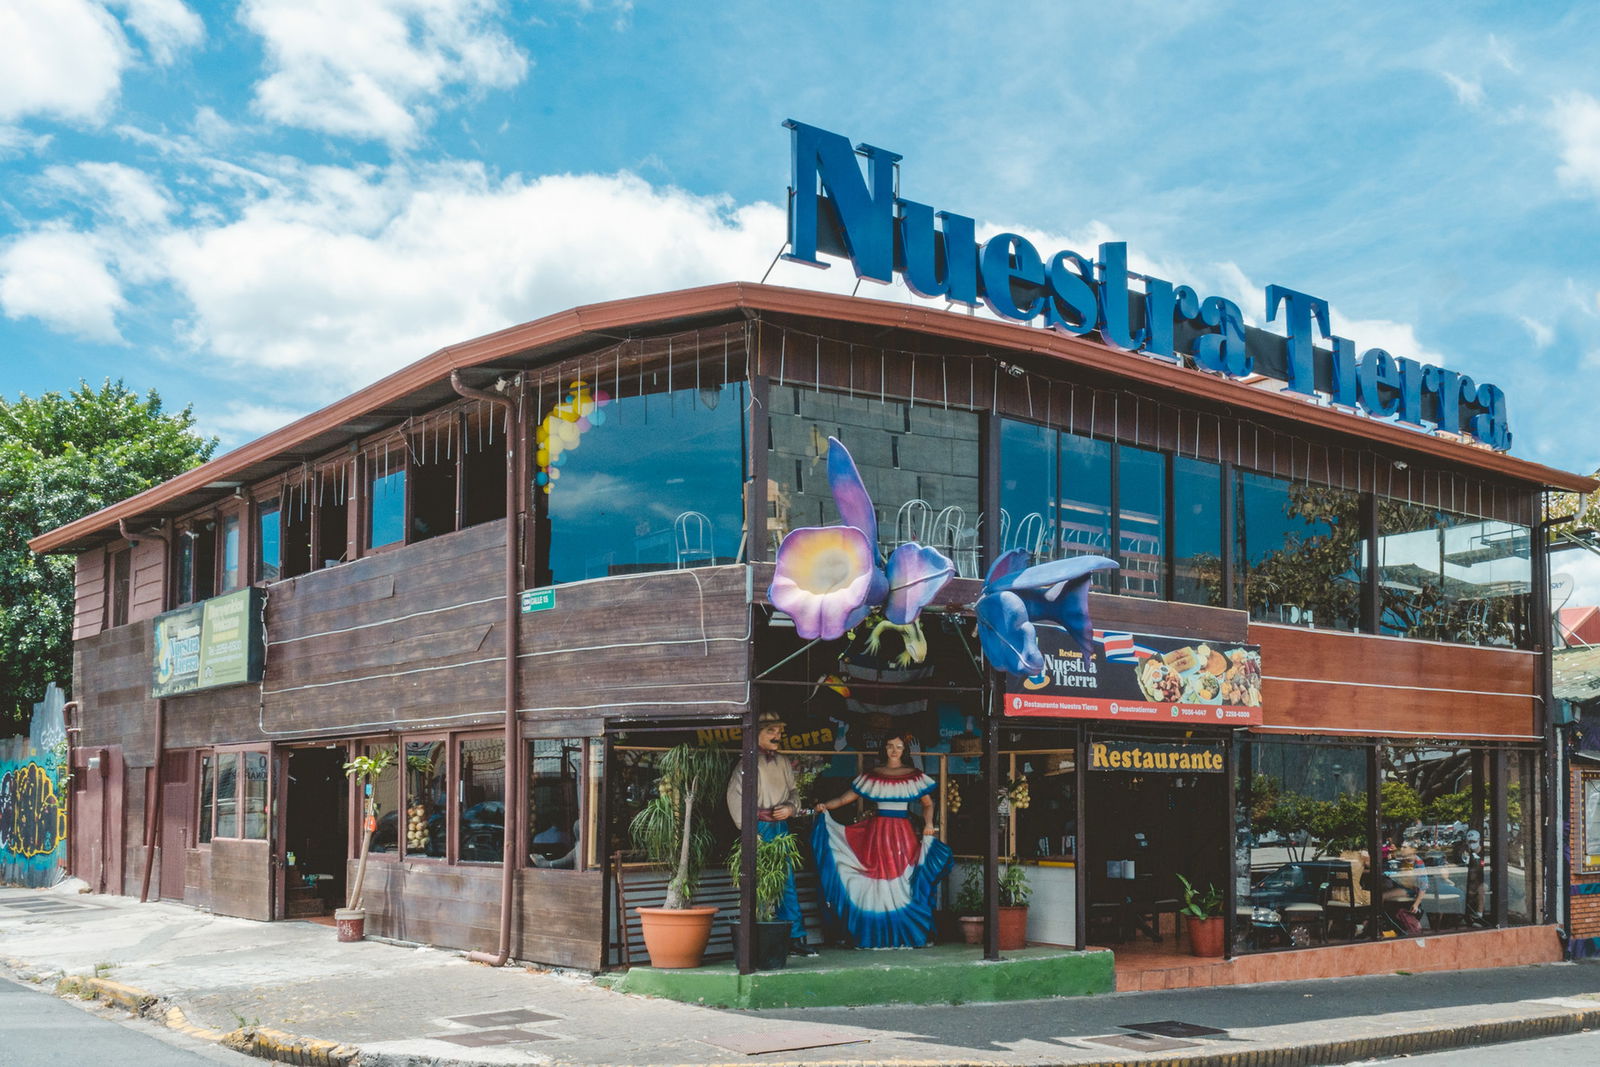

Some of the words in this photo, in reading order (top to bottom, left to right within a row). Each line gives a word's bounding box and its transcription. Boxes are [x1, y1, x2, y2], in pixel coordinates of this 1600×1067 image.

[781, 118, 1254, 379] Nuestra
[1266, 284, 1513, 450] Tierra
[1053, 669, 1098, 688] Tierra
[1023, 700, 1059, 709] Restaurante
[1059, 702, 1081, 710] Nuestra
[1082, 703, 1098, 711] Tierra
[780, 727, 833, 750] ierra
[1091, 743, 1223, 770] Restaurante
